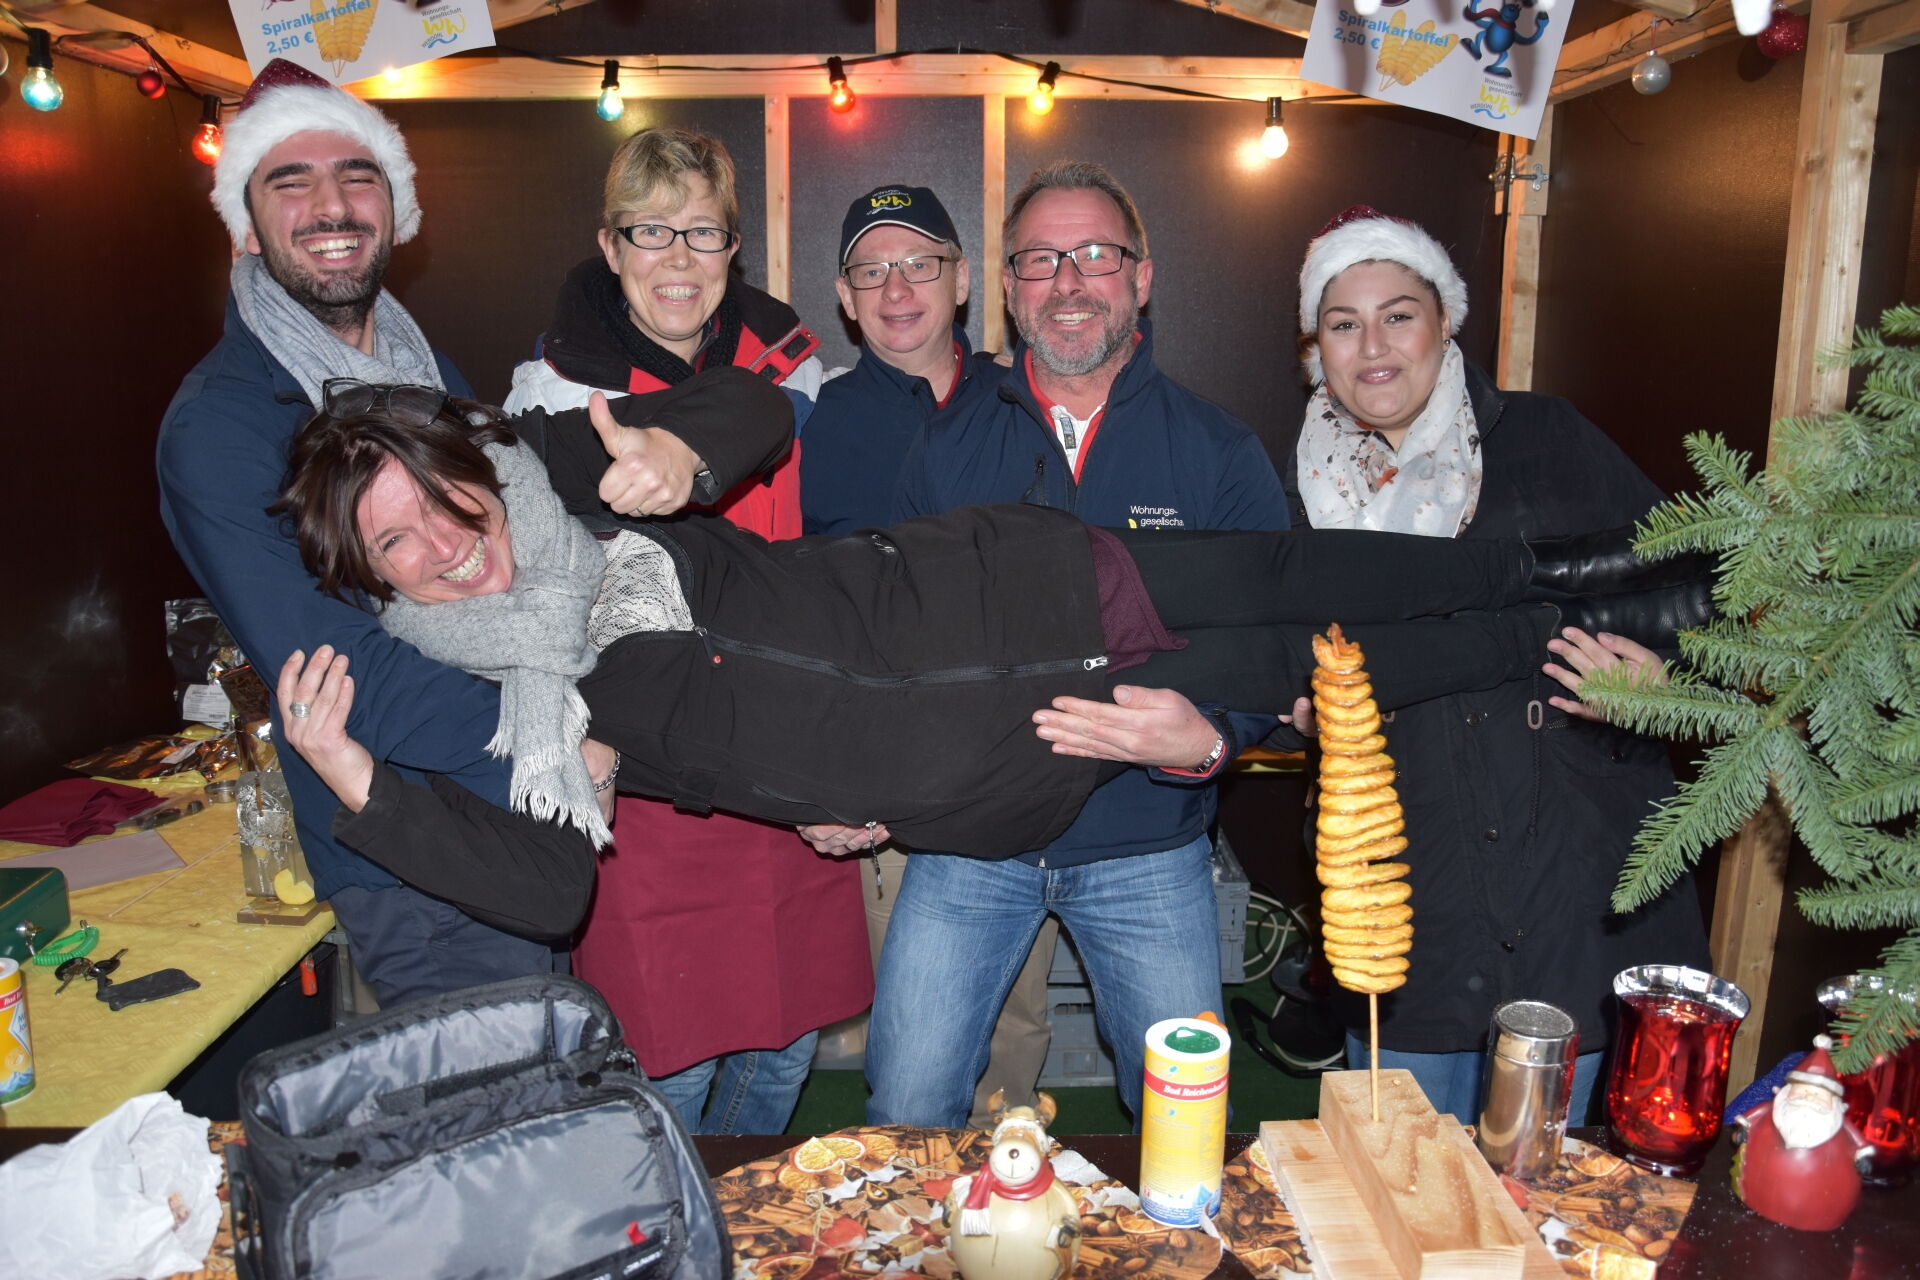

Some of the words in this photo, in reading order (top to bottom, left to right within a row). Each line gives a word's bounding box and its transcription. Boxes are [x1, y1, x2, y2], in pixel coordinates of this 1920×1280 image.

[261, 0, 371, 36] Spiralkartoffel
[1338, 9, 1451, 48] Spiralkartoffel
[266, 34, 300, 54] 2,50
[304, 31, 315, 43] €
[1333, 27, 1367, 46] 2,50
[1370, 37, 1381, 50] €
[1130, 505, 1179, 517] Wohnungs-
